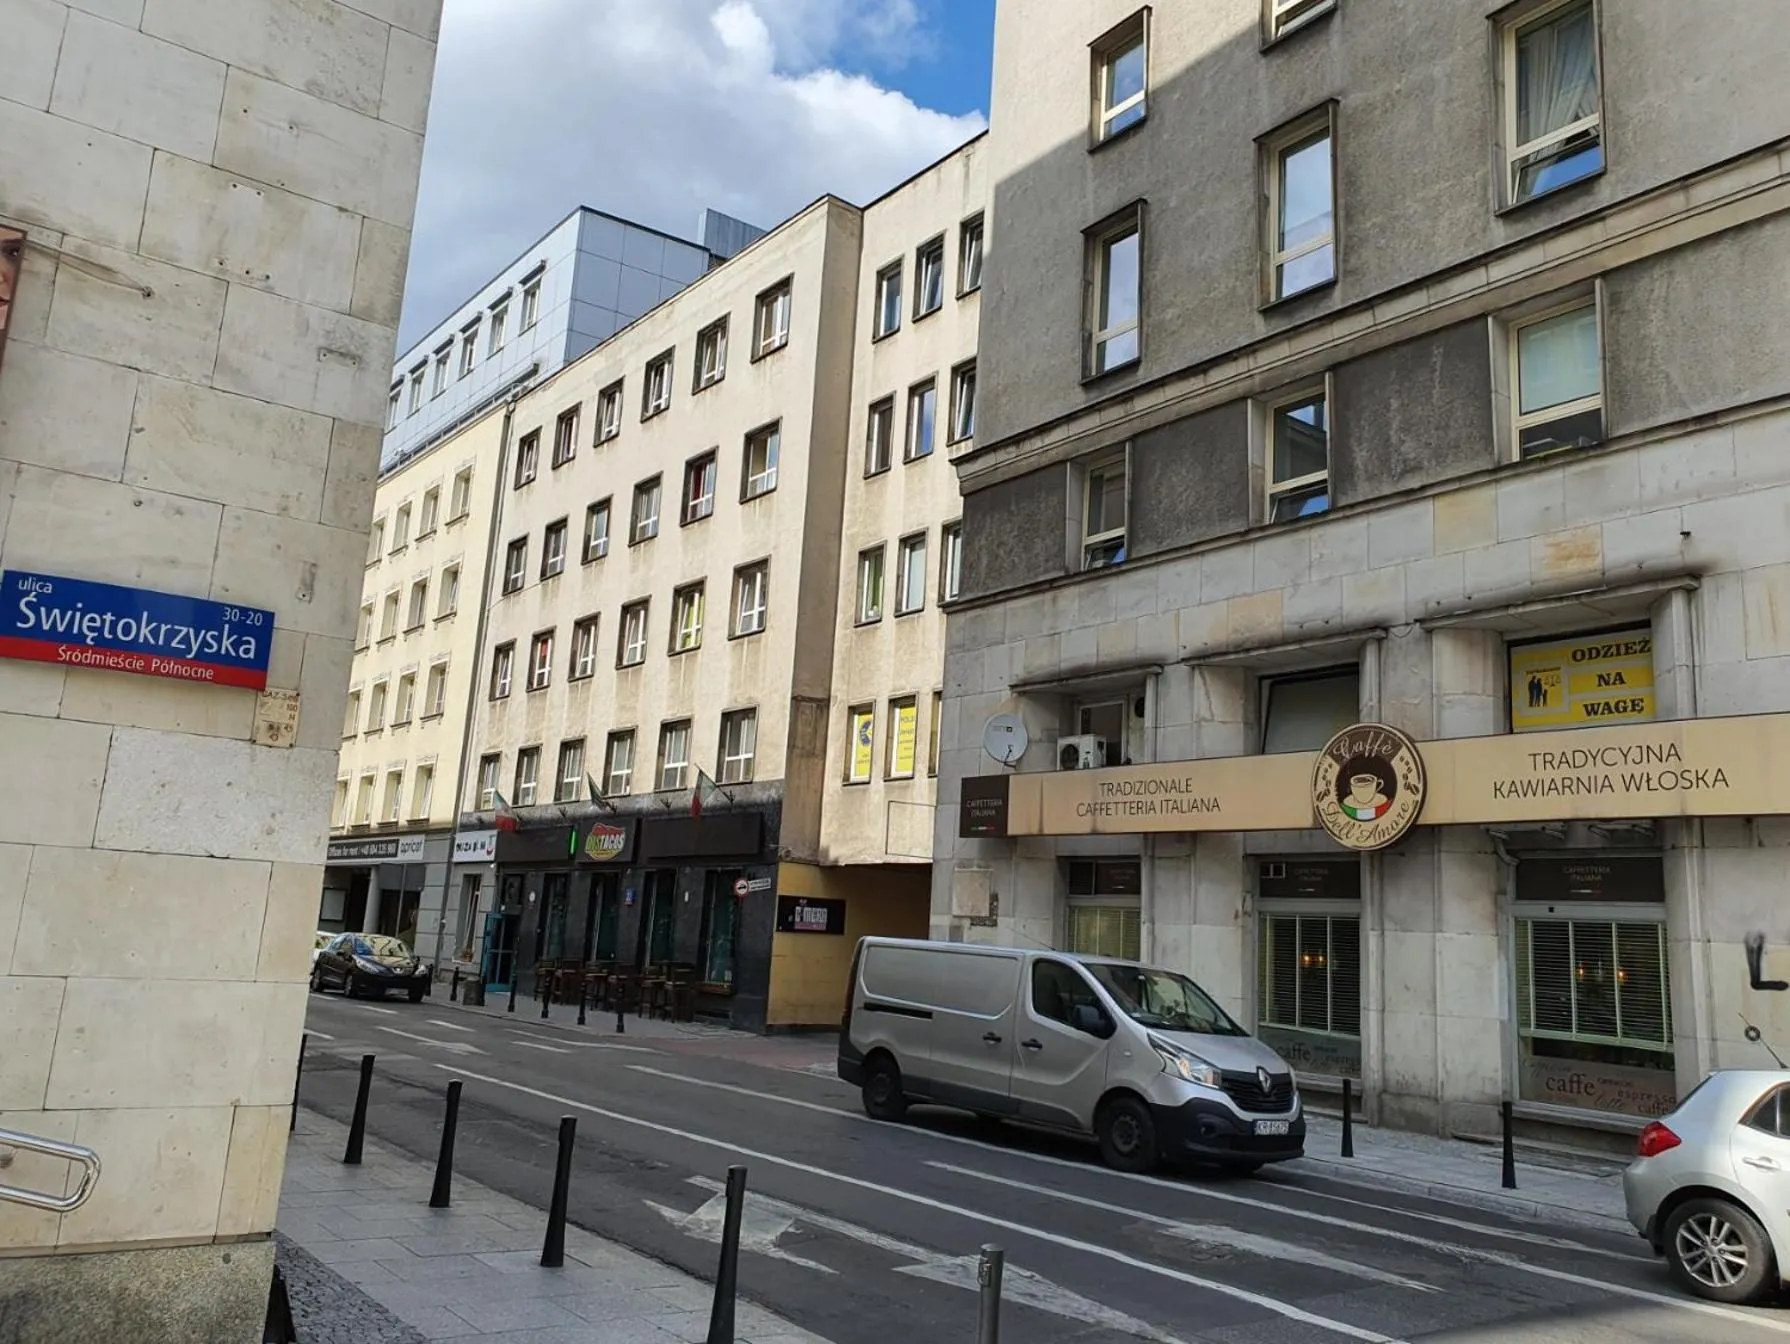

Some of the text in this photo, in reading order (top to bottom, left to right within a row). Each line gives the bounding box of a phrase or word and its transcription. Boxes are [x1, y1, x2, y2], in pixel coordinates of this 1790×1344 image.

[18, 577, 53, 594] ulica
[16, 592, 256, 660] Świętokrzyska
[222, 607, 263, 626] 30-20
[57, 644, 214, 680] Śródmieście Północne
[1571, 638, 1652, 664] ODZIEŻ
[1597, 671, 1626, 688] NA
[1583, 698, 1645, 718] WAGĘ
[1333, 731, 1394, 760] Caffè
[1528, 743, 1682, 772] TRADYCYJNA
[1099, 777, 1193, 797] TRADIZIONALE
[1493, 768, 1730, 800] KAWIARNIA WŁOSKA
[1076, 796, 1222, 818] CAFFETTERIA ITALIANA
[1545, 1073, 1596, 1097] caffe
